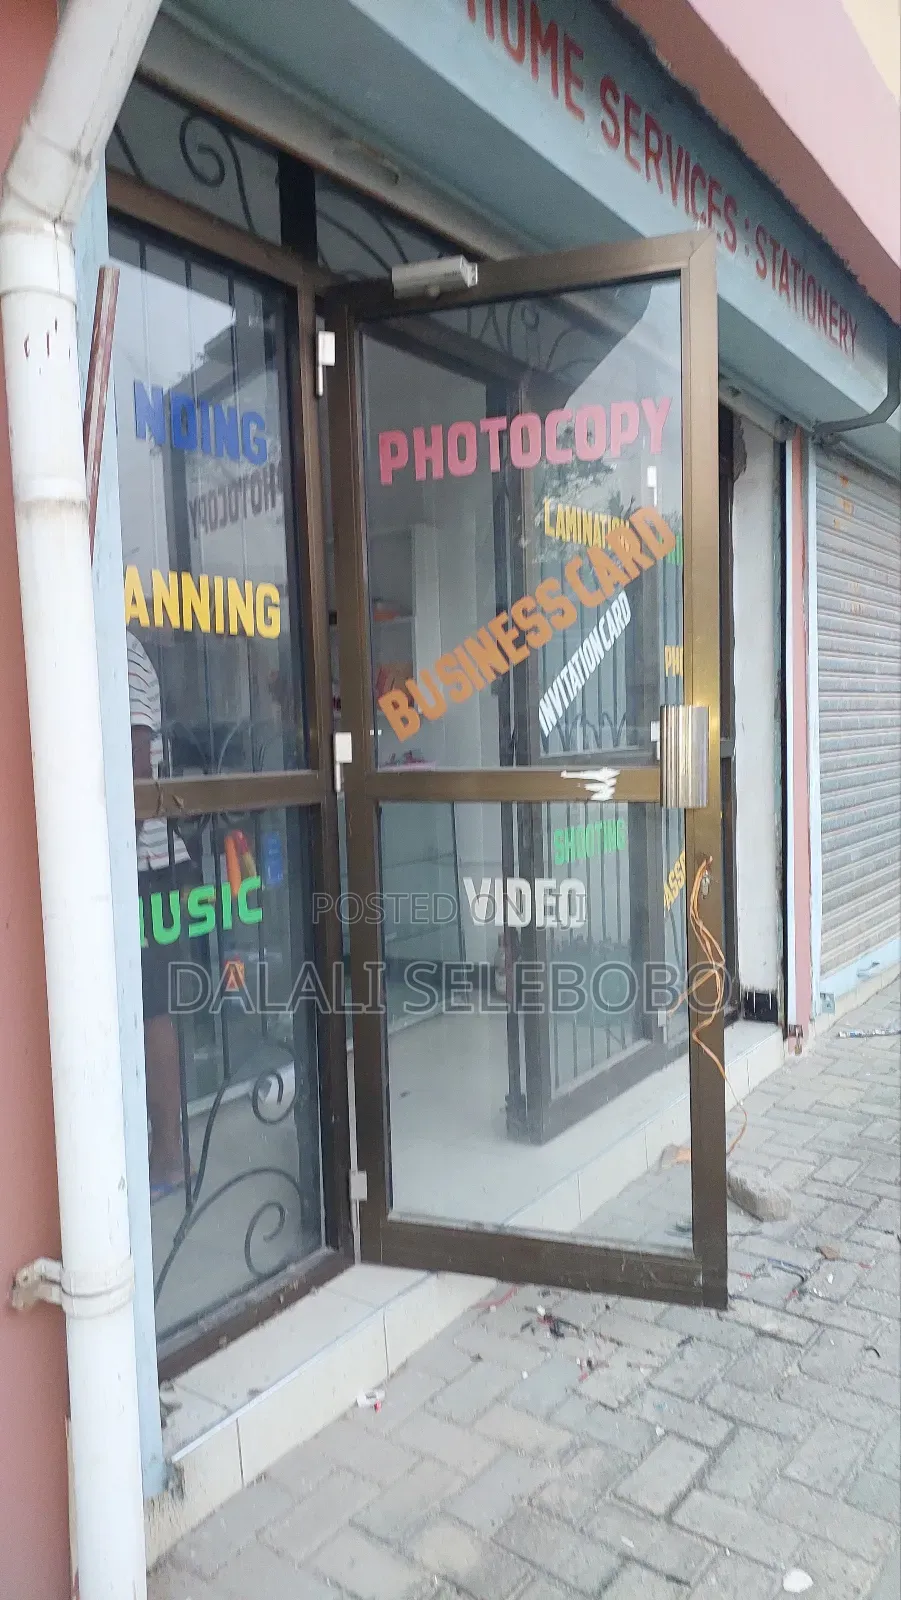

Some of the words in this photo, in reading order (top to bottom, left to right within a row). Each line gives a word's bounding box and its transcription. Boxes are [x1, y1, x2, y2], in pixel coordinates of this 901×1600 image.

[756, 223, 857, 361] STATIONERY
[134, 379, 268, 466] NDING
[378, 396, 672, 486] PHOTOCOPY
[124, 565, 281, 639] ANNING
[378, 577, 578, 742] BUSINESS
[564, 506, 676, 608] CARD
[538, 624, 605, 738] INVITATION
[598, 590, 632, 652] CARD
[554, 818, 627, 865] SHOOTING
[463, 877, 587, 928] VIDEO
